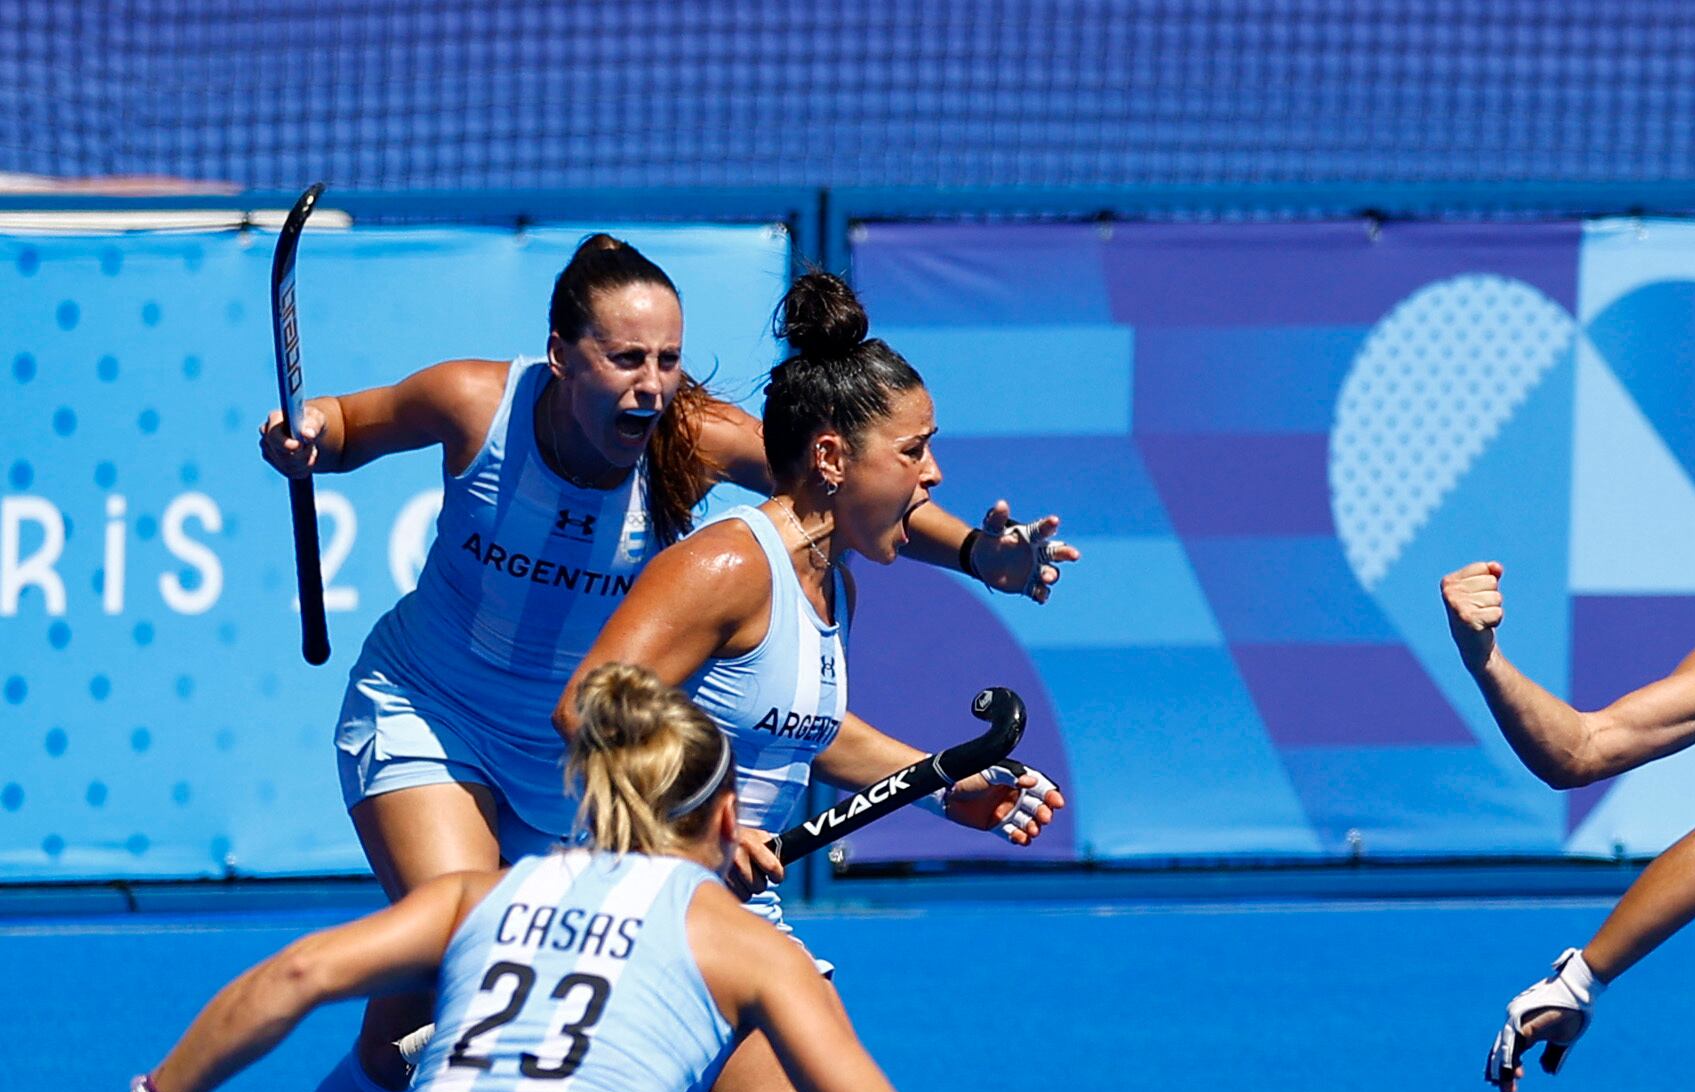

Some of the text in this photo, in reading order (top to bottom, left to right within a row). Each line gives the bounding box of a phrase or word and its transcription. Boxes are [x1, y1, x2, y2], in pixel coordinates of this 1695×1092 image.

[803, 770, 910, 837] VLACK
[496, 903, 644, 960] CASAS
[448, 961, 611, 1079] 23
